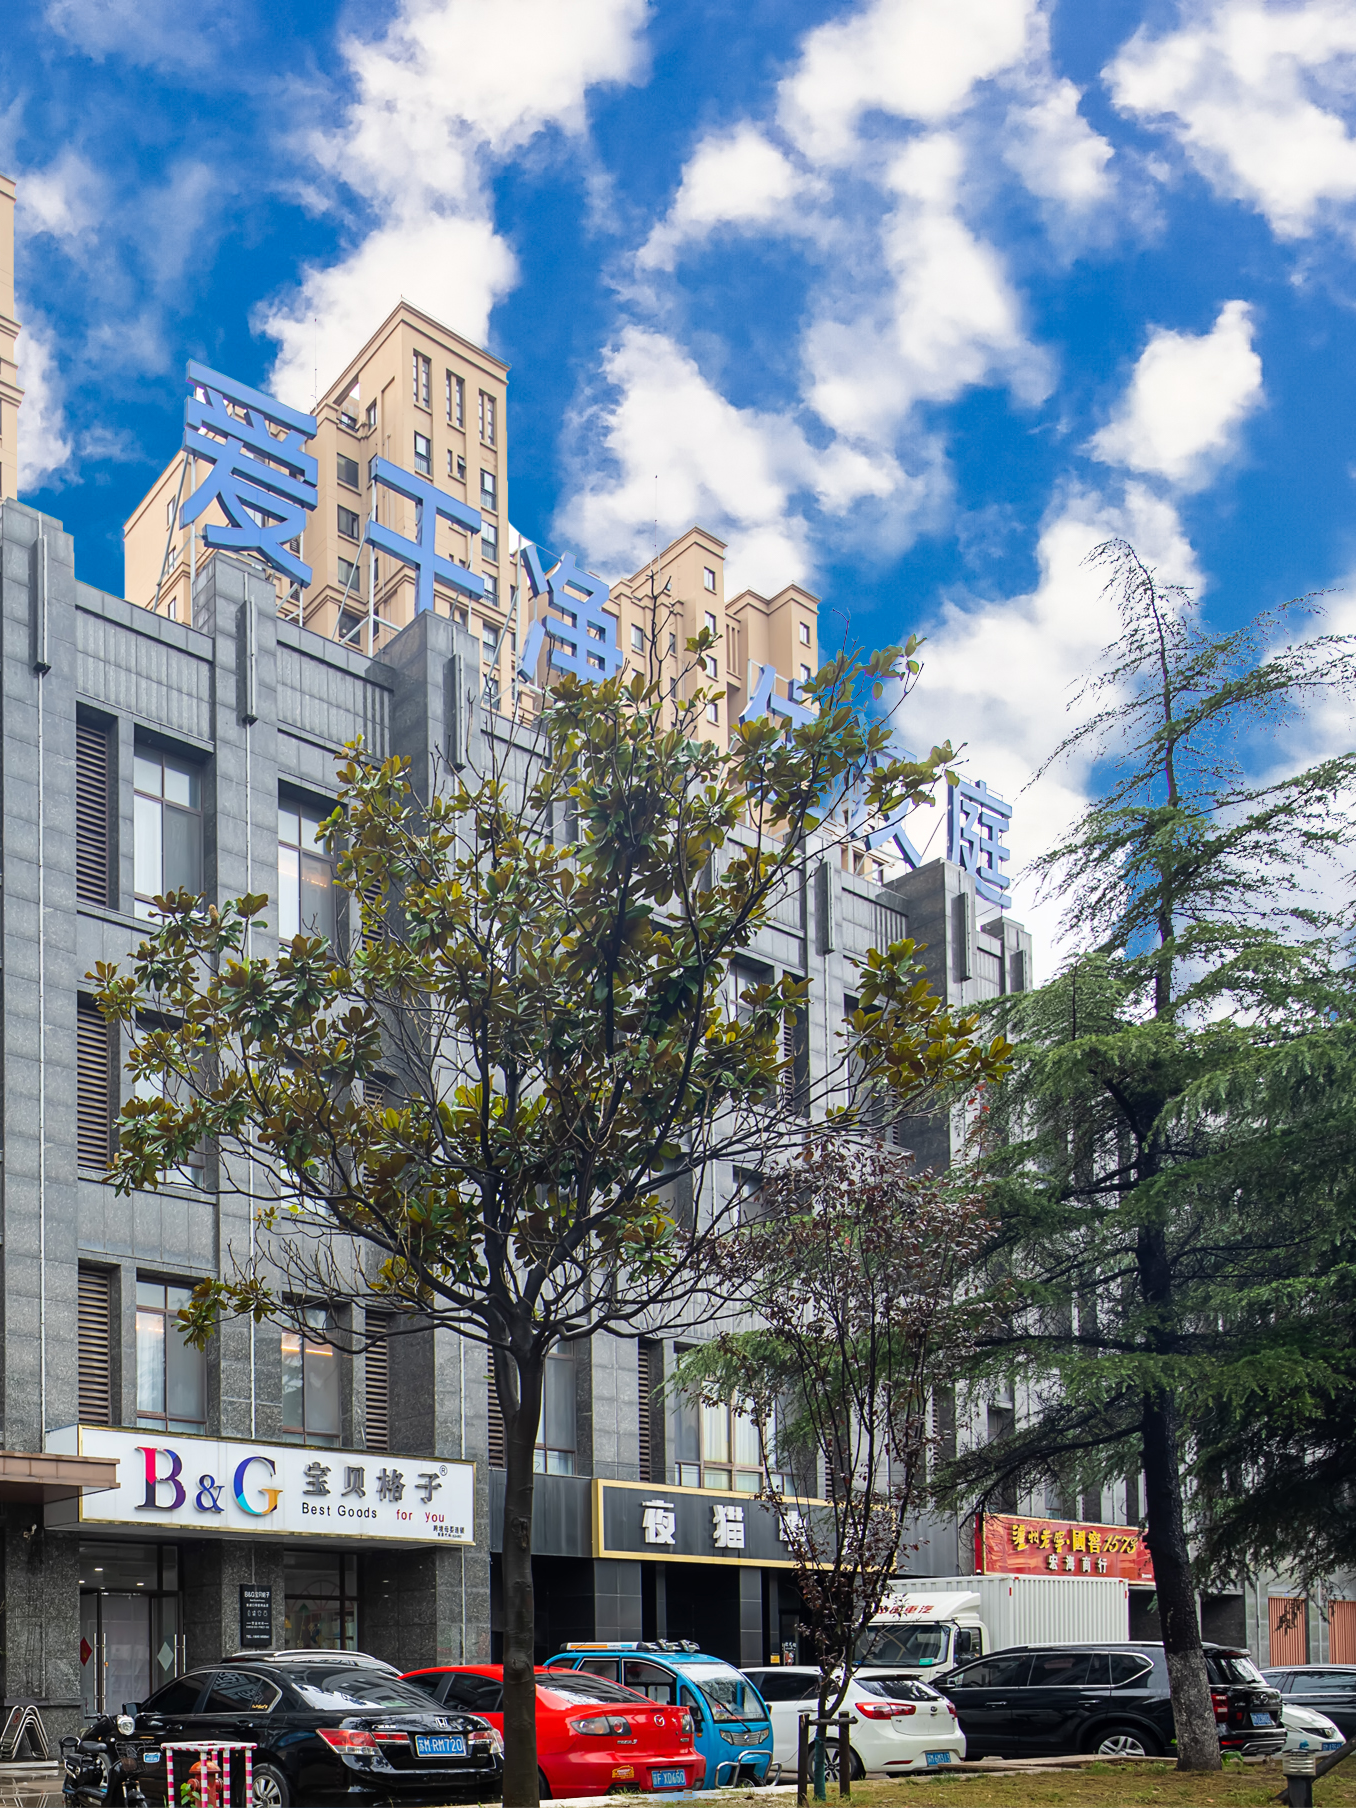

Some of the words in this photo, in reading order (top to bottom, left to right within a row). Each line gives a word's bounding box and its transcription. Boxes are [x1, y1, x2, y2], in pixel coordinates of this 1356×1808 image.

[135, 1446, 284, 1517] B&G
[302, 1461, 443, 1504] 宝贝格子
[302, 1502, 331, 1517] Best
[337, 1504, 378, 1519] Goods
[396, 1509, 413, 1521] for
[1047, 1553, 1108, 1574] 宏海商行
